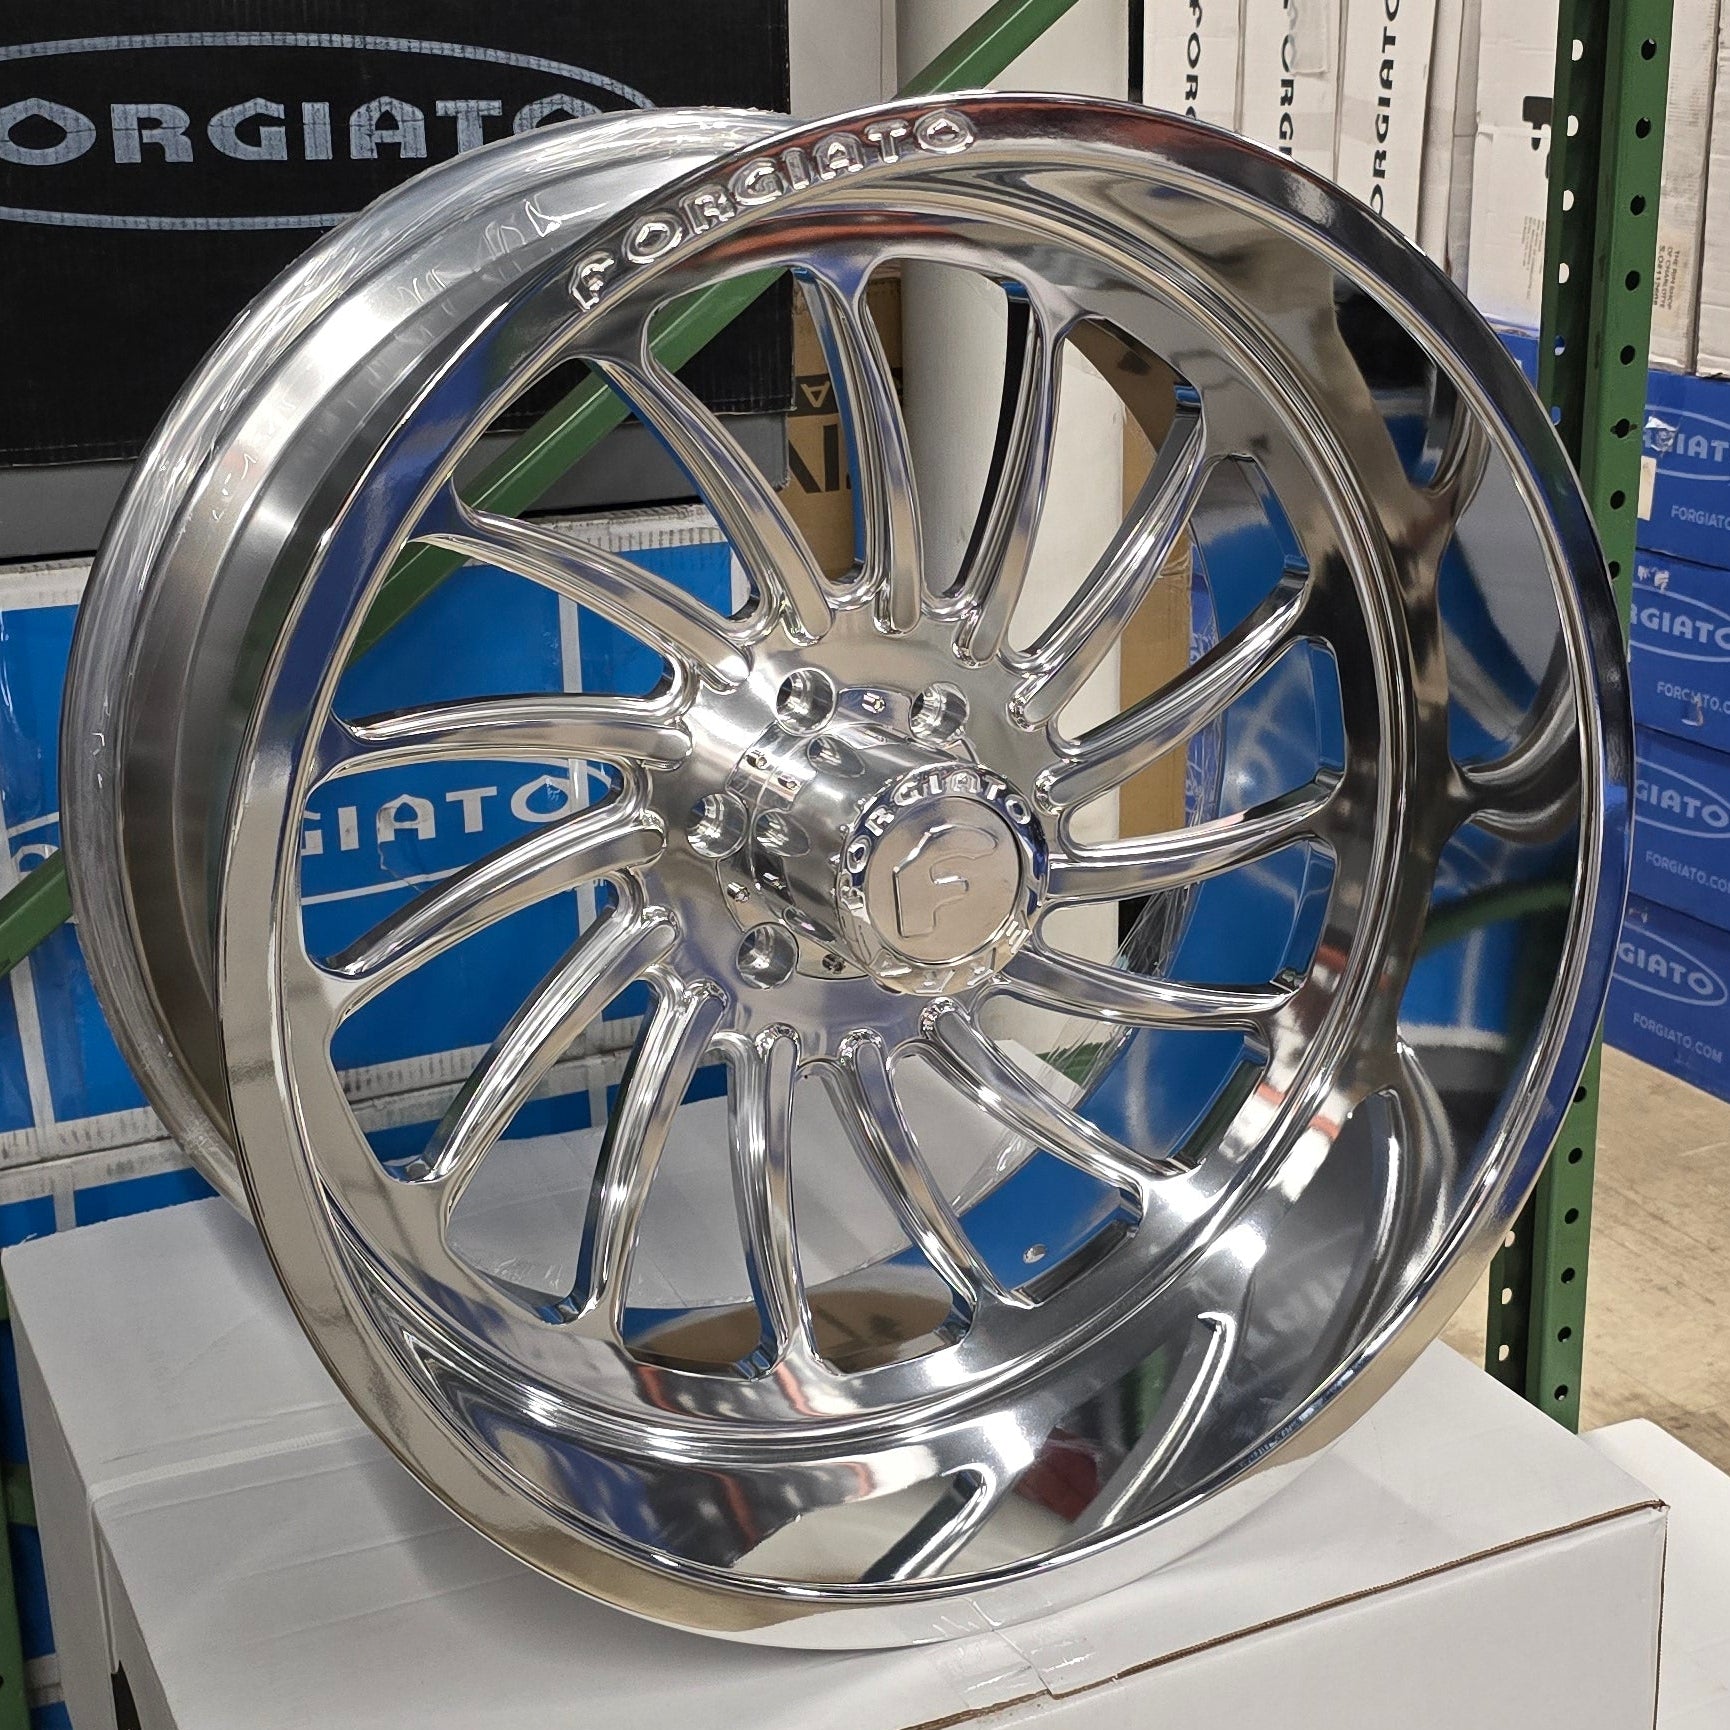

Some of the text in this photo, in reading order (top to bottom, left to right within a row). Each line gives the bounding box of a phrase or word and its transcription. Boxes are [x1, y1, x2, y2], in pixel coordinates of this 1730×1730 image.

[568, 107, 978, 312] FORGIATO
[1645, 850, 1730, 894] FORGIATO.CO
[1632, 1012, 1723, 1064] FORGIATO.COM
